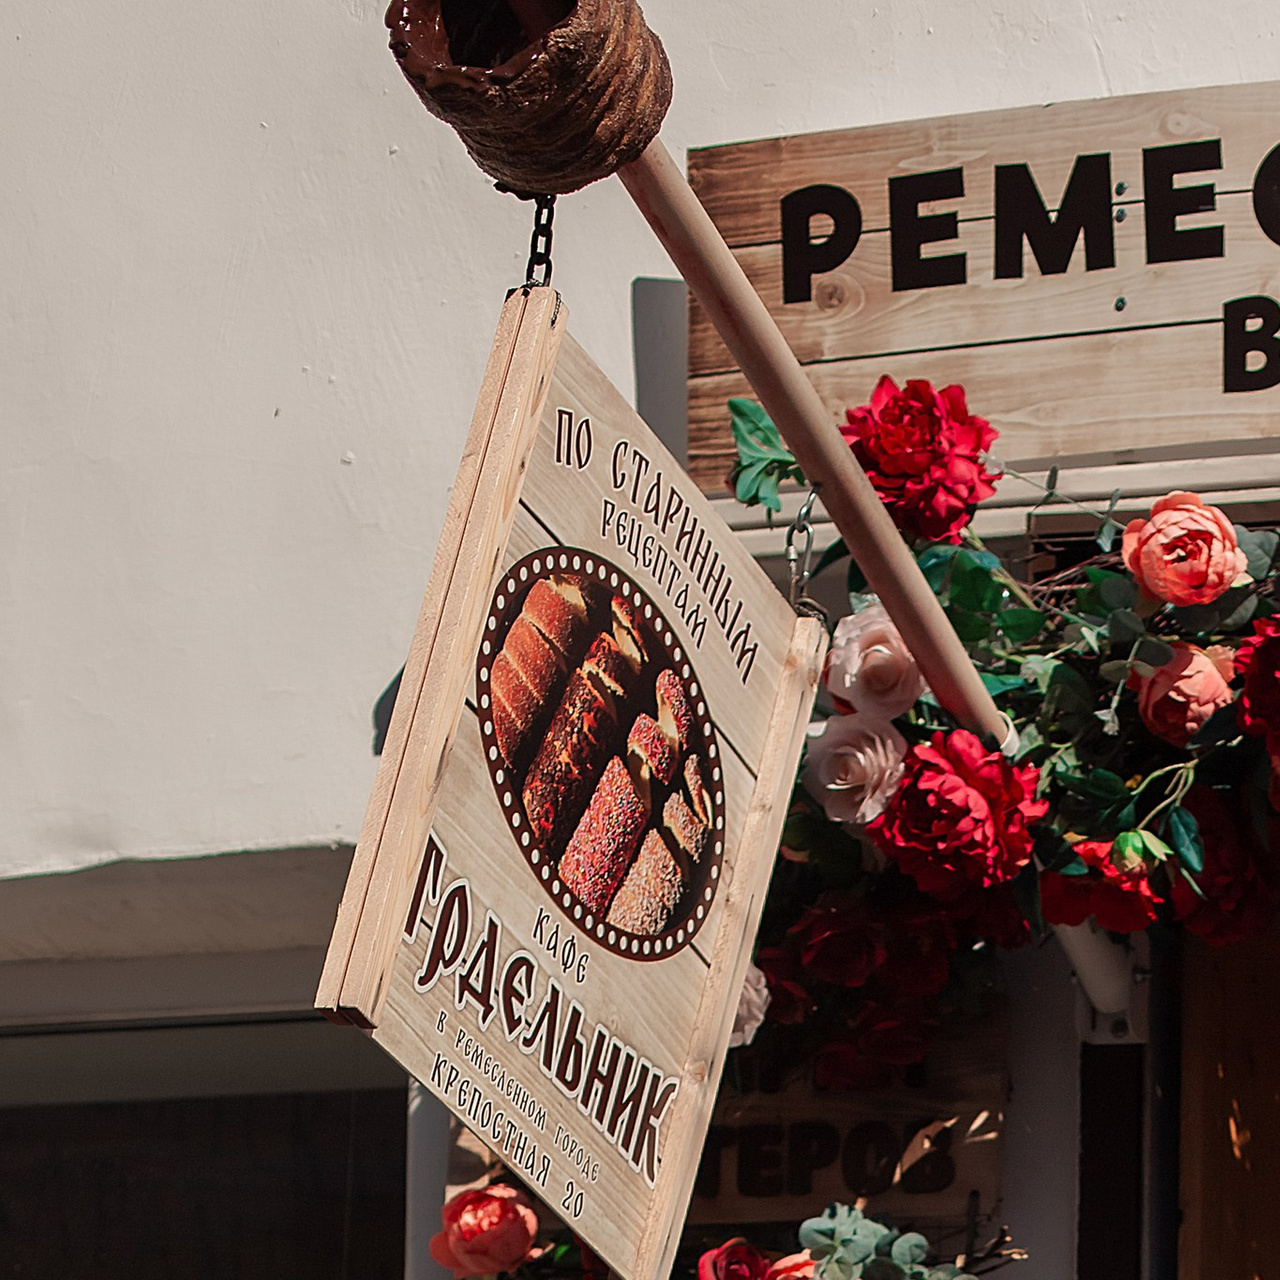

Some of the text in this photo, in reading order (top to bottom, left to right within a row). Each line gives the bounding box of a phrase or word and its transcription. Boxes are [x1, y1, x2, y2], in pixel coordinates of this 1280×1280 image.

[556, 408, 759, 686] ПО СТАРИННЫМ
[602, 498, 708, 650] РЕЦЕПТАМ
[533, 907, 590, 984] КАФЕ
[430, 1052, 585, 1218] КРЕПОСТНАЯ 20
[436, 1010, 600, 1182] В РЕМЕСЛЕННОМ ГОРОДЕ
[700, 1118, 957, 1198] ТЕРОВ
